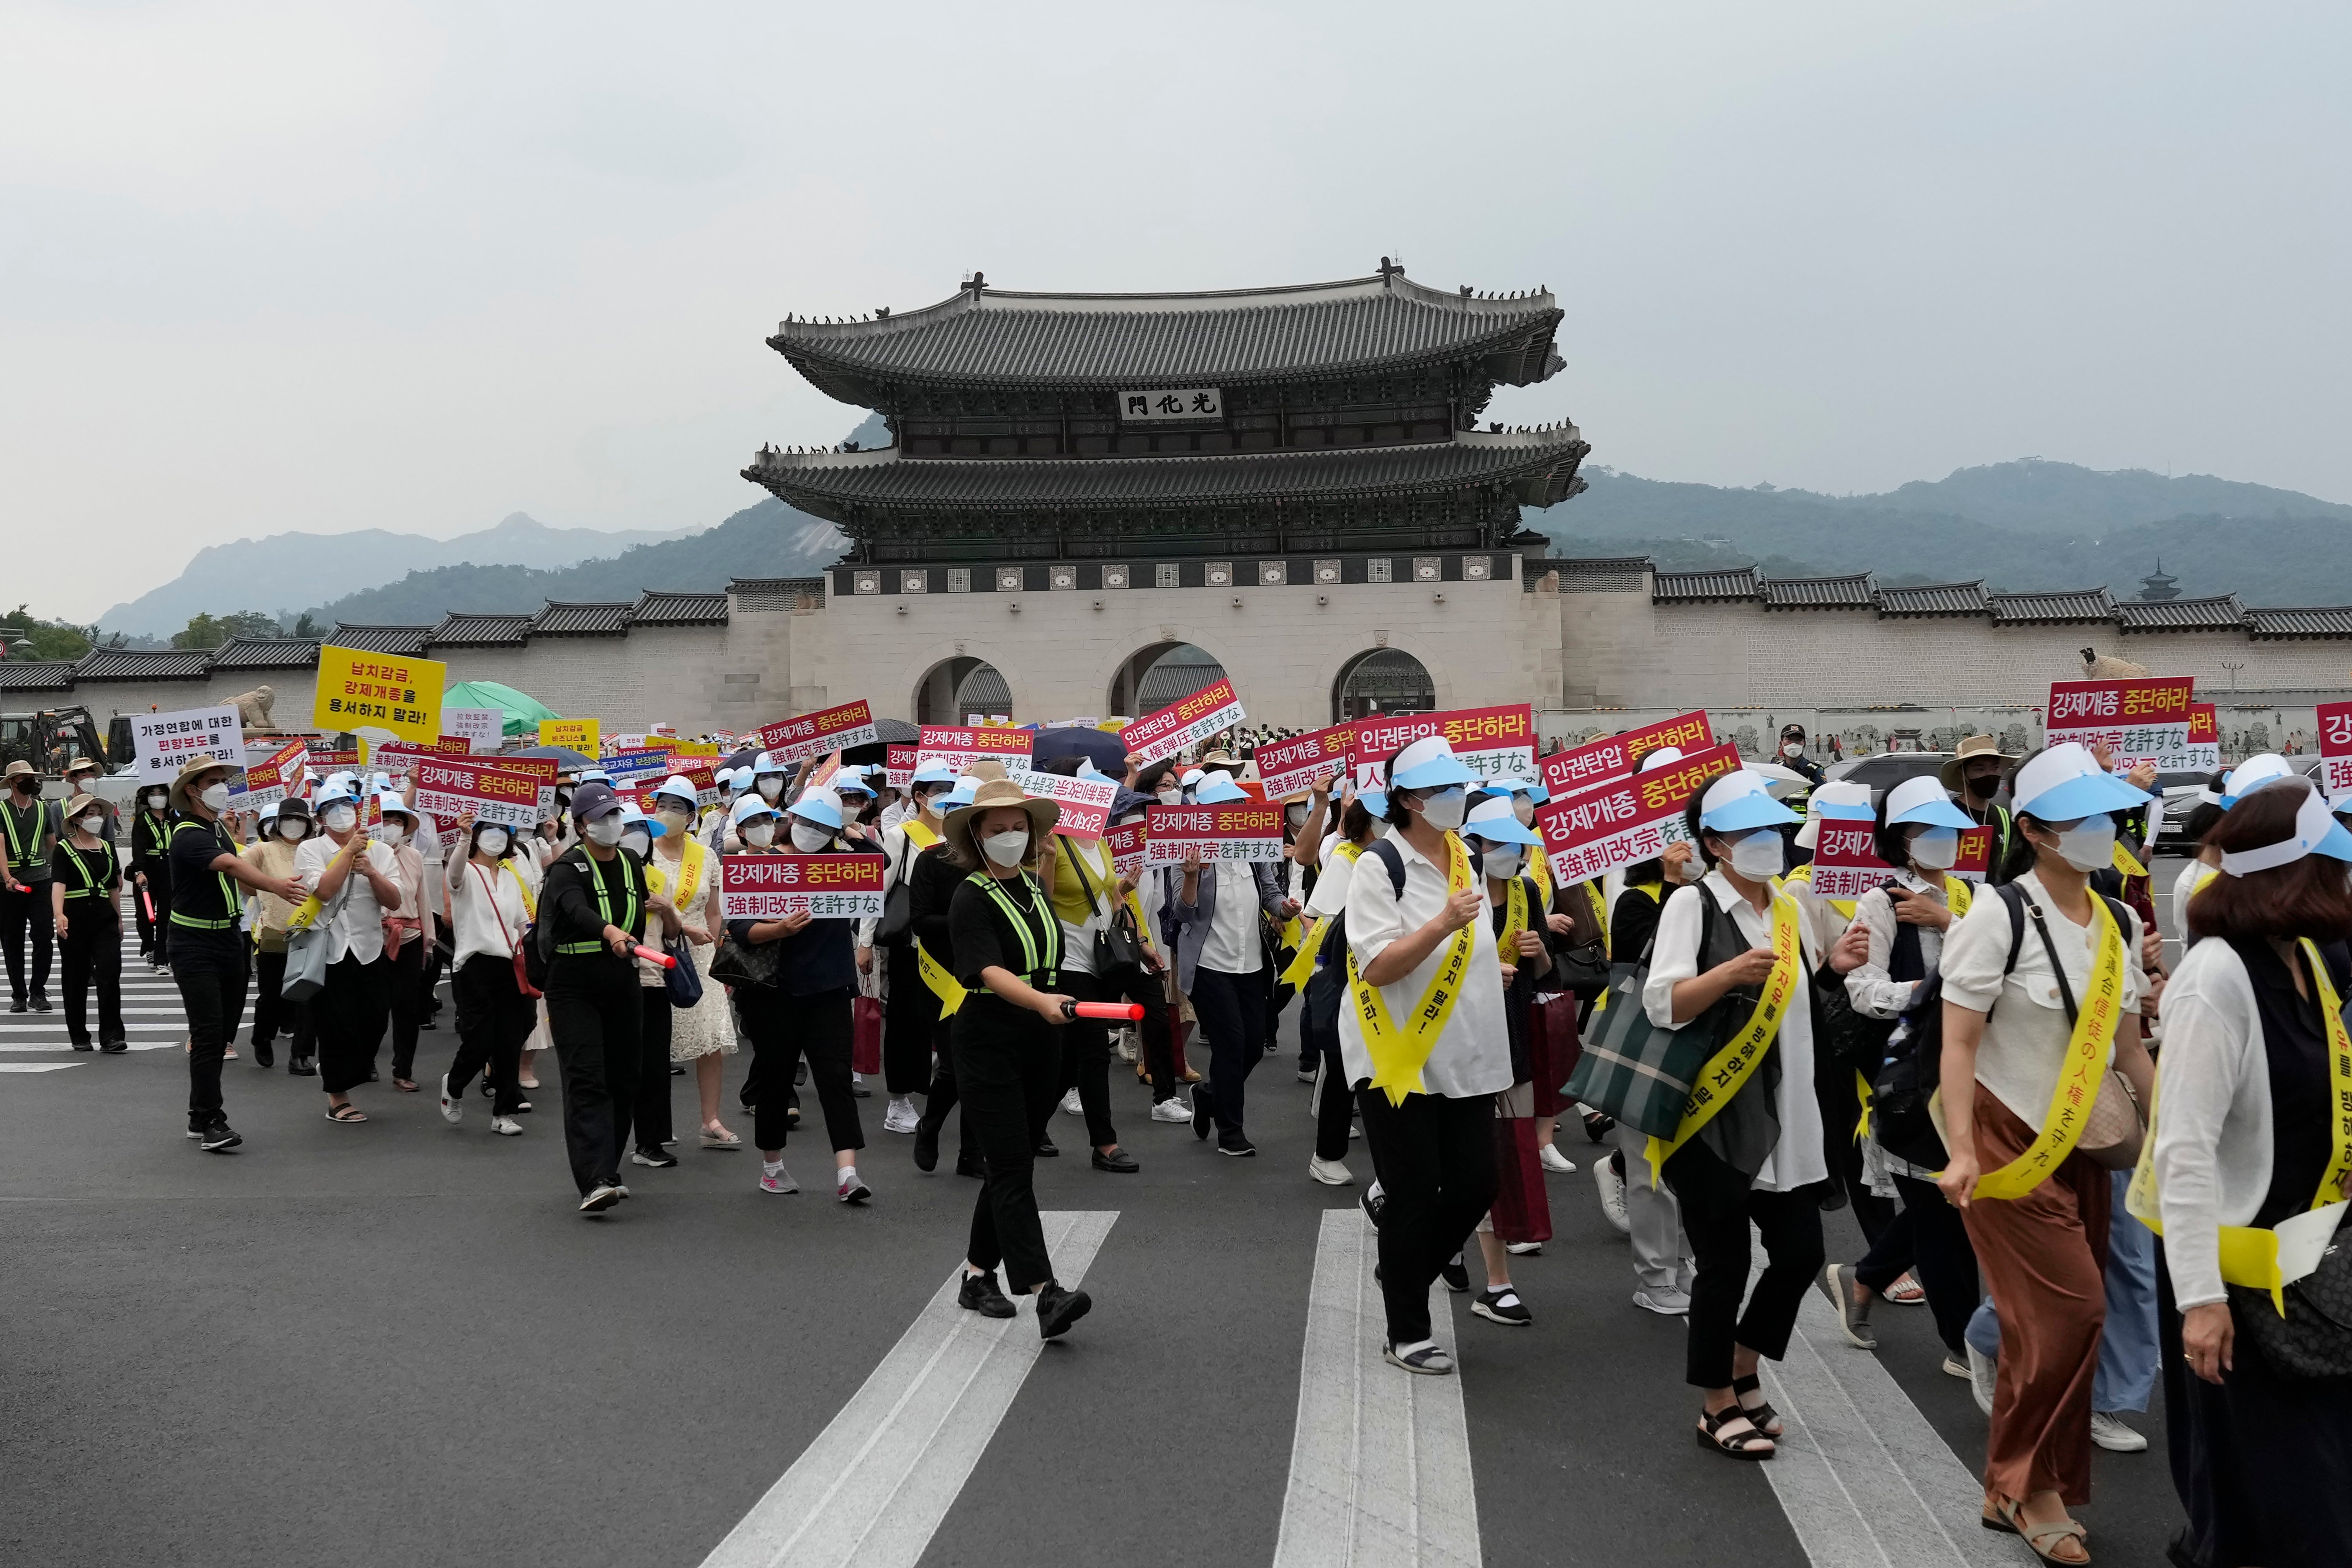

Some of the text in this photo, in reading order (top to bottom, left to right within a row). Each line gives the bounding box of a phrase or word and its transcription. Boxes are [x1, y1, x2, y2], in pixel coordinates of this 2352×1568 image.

[352, 662, 412, 684] 납치감금,
[345, 681, 416, 704] 강제개종을
[2052, 686, 2188, 719] 강제개종 중단하라
[141, 716, 232, 737] 가정연합에 대한
[329, 699, 427, 725] 용서하지 말라!
[765, 720, 815, 744] 강제개종
[817, 705, 867, 731] 중단하라
[1125, 684, 1230, 746] 인권탄압 중단하라
[1443, 713, 1526, 744] 중단하라
[158, 733, 220, 751] 편향보도를
[771, 728, 874, 766] 強制改宗を許すな
[922, 730, 1030, 749] 강제개종 중단하라
[1138, 707, 1240, 767] 人権弾圧を許すな
[1259, 739, 1320, 770] 강제개종
[1324, 728, 1357, 753] 중단
[1548, 745, 1623, 785] 인권탄압
[421, 766, 475, 789] 강제개종
[479, 775, 535, 799] 중단하라
[419, 792, 532, 824] 強制改宗を許すな
[1152, 811, 1280, 831] 강제개종 중단하라
[1544, 789, 1637, 841] 강제개종
[728, 862, 879, 884] 강제개종 중단하라
[728, 895, 879, 915] 強制改宗を許すな
[1359, 989, 1381, 1036] 말라!
[1418, 989, 1449, 1034] 말라!
[1712, 1024, 1767, 1089] 방해하지
